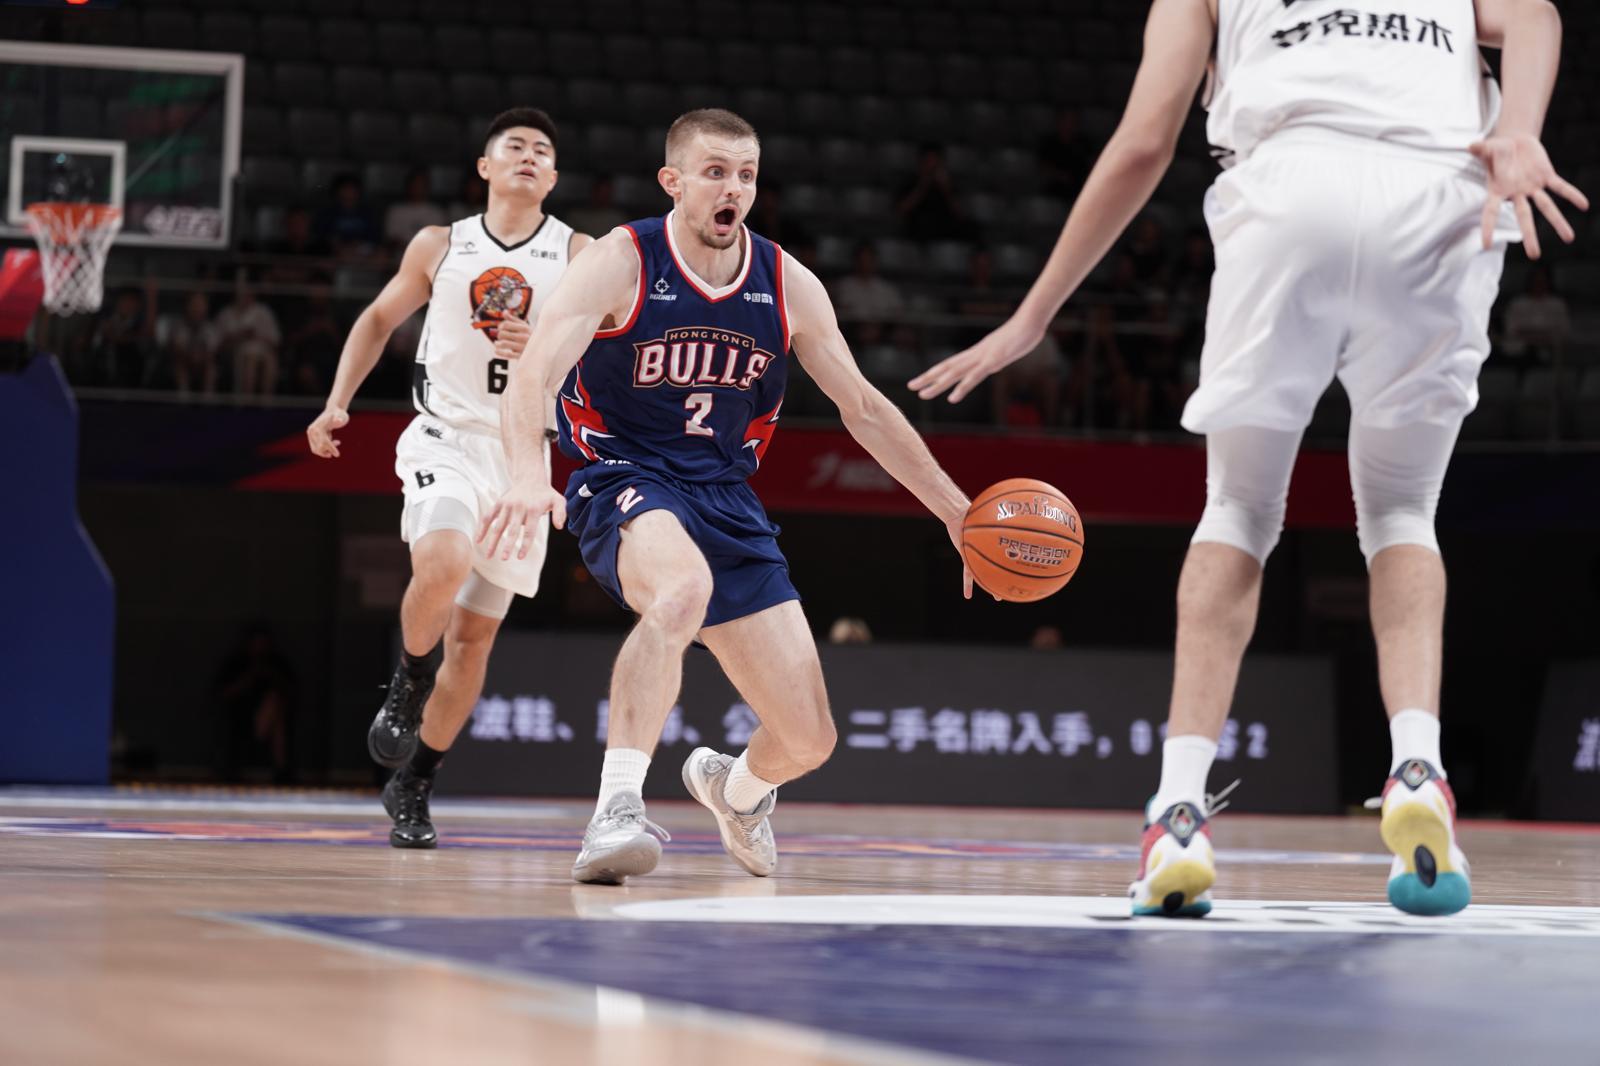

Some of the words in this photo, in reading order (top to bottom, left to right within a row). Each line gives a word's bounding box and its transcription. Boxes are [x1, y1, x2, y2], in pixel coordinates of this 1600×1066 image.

[669, 330, 708, 341] HONG
[712, 331, 750, 348] KONG
[487, 357, 509, 395] 6
[636, 341, 769, 388] BULLS
[684, 392, 714, 437] 2
[615, 485, 645, 514] 2
[996, 497, 1078, 534] SPALDING
[999, 536, 1072, 559] PRECISION
